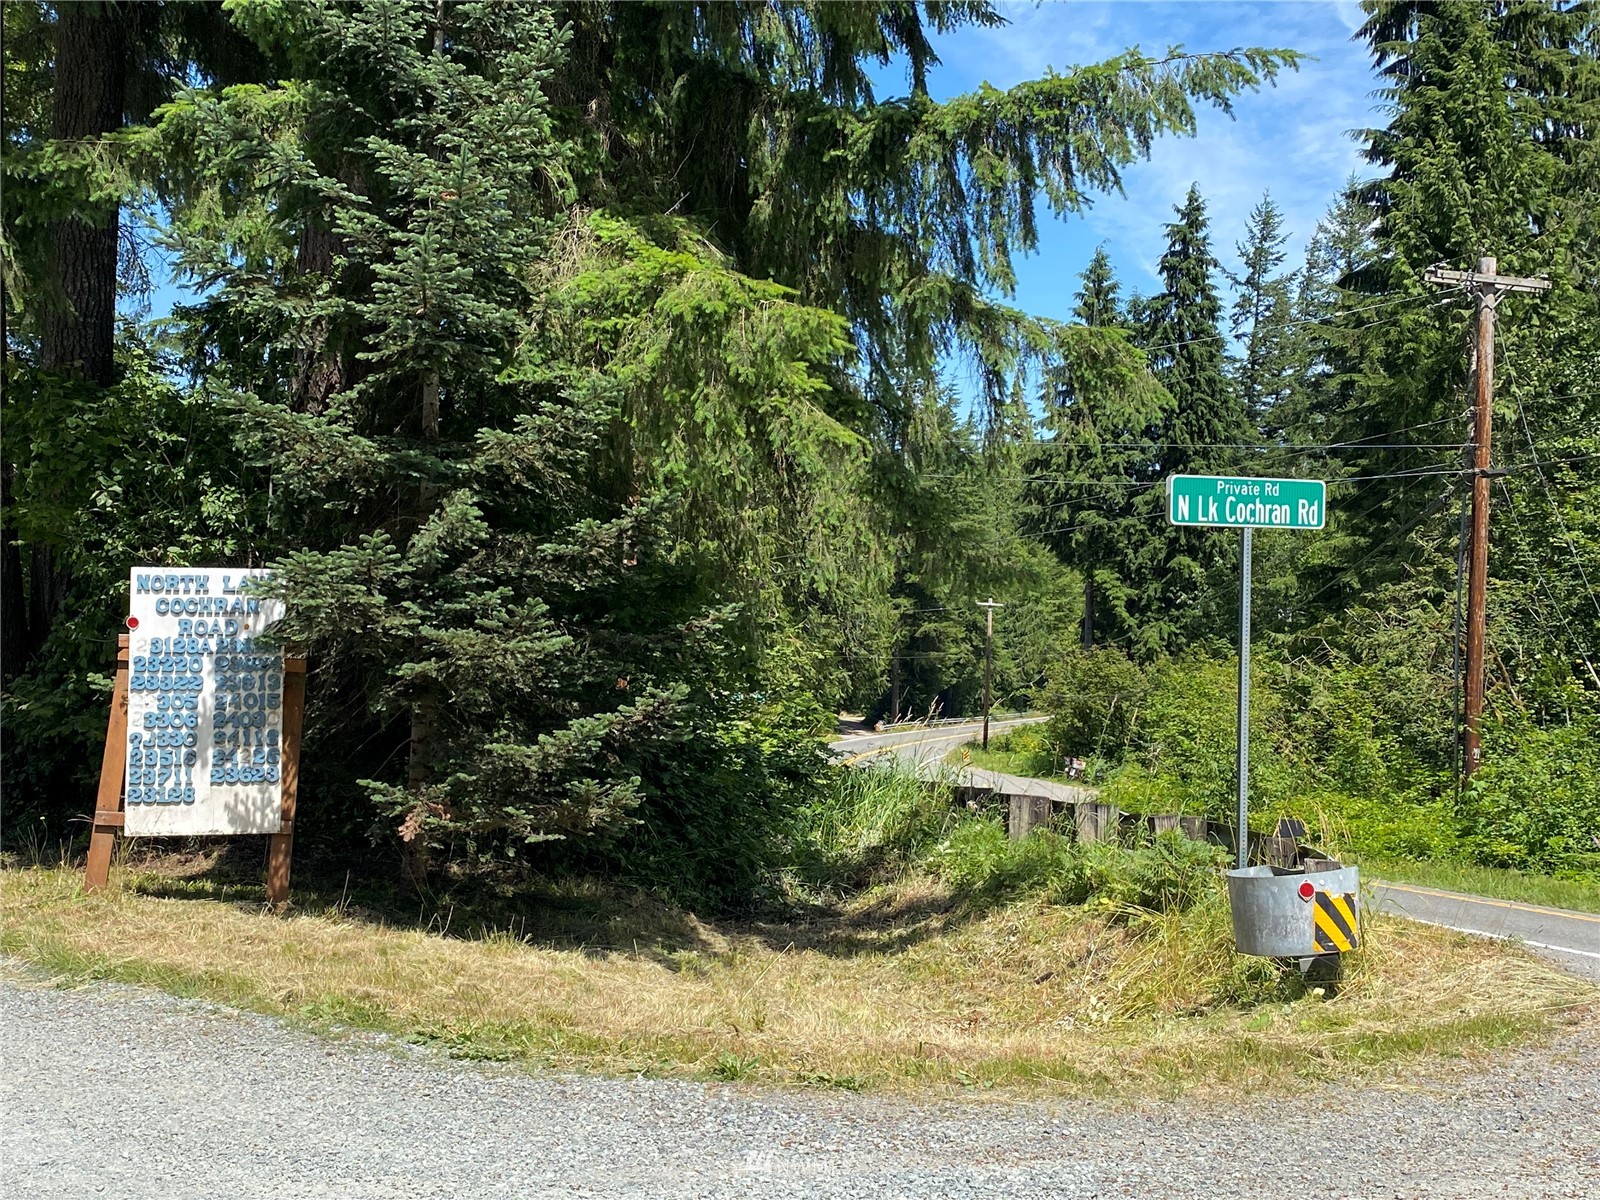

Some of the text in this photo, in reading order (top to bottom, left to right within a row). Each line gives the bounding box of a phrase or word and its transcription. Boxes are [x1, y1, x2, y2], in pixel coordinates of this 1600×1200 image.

[1217, 480, 1280, 497] Private Rd
[1178, 494, 1318, 526] N Lk Cochran Rd
[136, 574, 210, 594] NORTH
[155, 597, 261, 617] COCHRAN
[178, 619, 239, 638] ROAD
[133, 656, 204, 675] 23220
[130, 674, 204, 693] 23322
[128, 767, 194, 787] 23711
[210, 766, 280, 786] 23623
[127, 786, 196, 806] 23128
